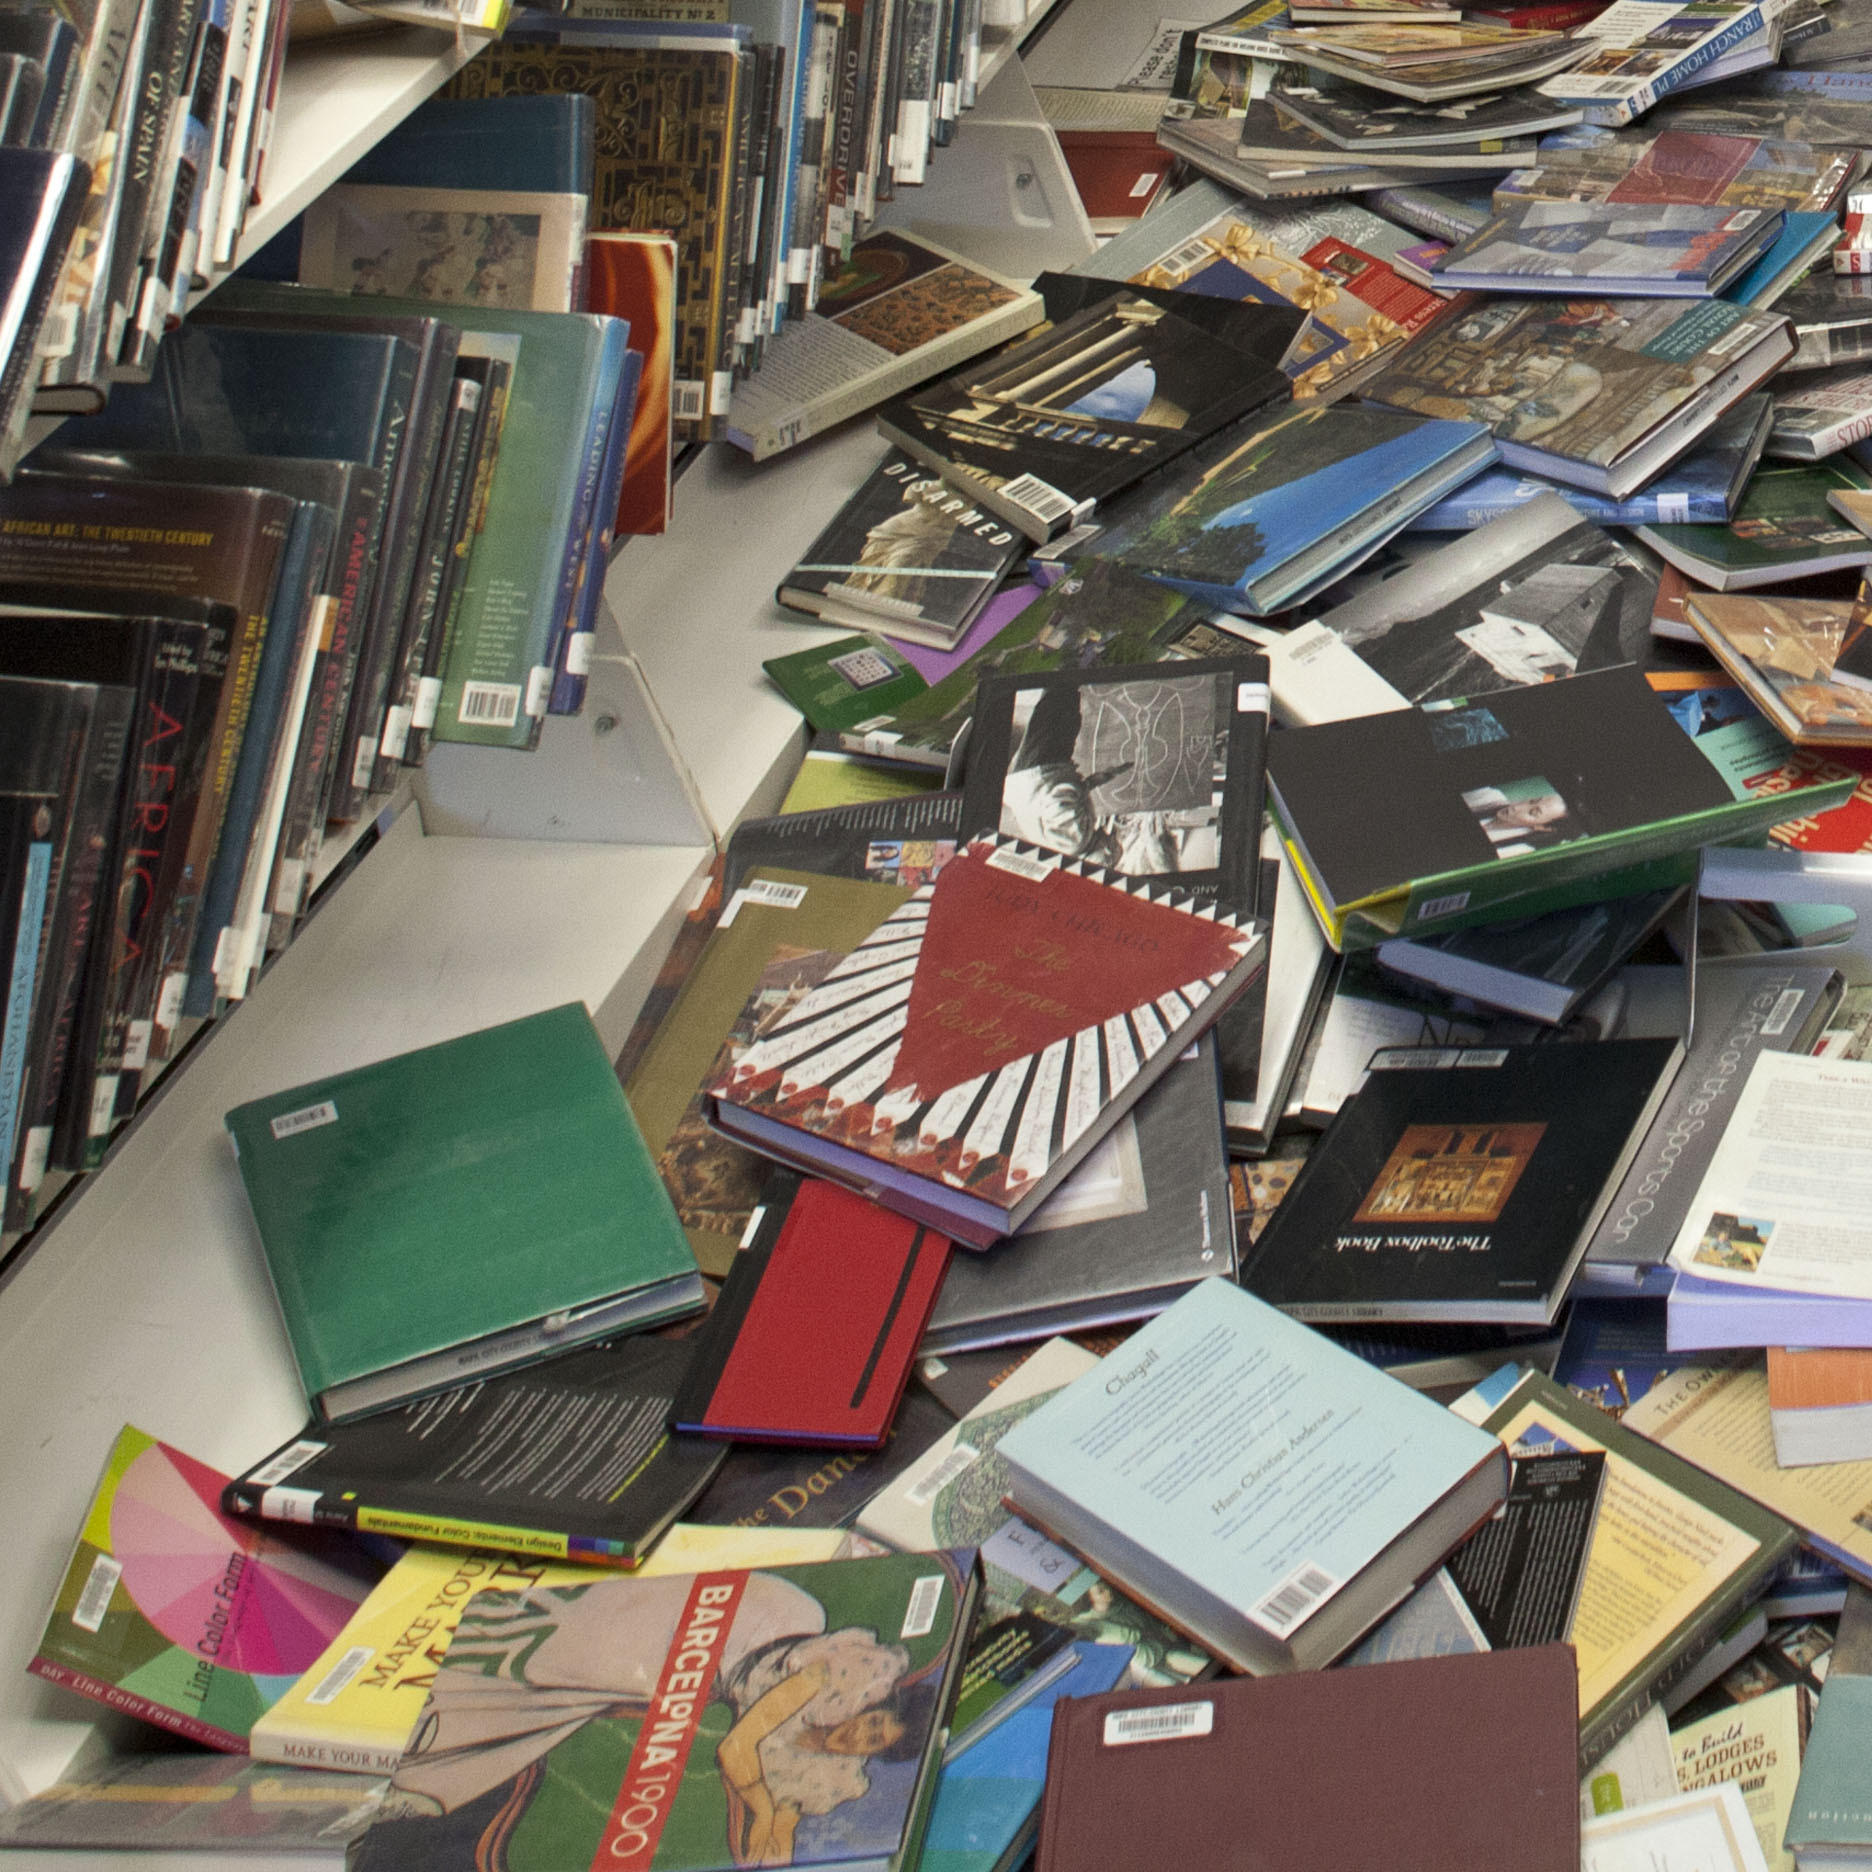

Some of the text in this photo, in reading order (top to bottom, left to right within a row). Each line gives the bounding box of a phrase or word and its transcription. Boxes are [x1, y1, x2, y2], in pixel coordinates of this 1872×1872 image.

[241, 6, 258, 52] ART
[1668, 12, 1759, 85] RANCH HOME
[133, 71, 164, 183] OF SPAIN
[831, 50, 860, 206] OVERDRIVE
[881, 455, 1017, 553] DISARMED
[108, 699, 184, 983] AFRICA
[1012, 940, 1068, 971] The
[941, 963, 1074, 1020] Dinner
[922, 998, 1019, 1052] Party
[1632, 1106, 1706, 1200] Sports
[1334, 1234, 1491, 1252] The Toolbox Book
[1606, 1189, 1657, 1249] Car
[1101, 1346, 1163, 1401] Chagall
[1209, 1402, 1337, 1515] Hans Christian Andersen
[441, 1526, 471, 1539] Color
[524, 1534, 562, 1551] Design
[184, 1549, 252, 1704] Line Color Form
[360, 1608, 441, 1698] MAKE
[39, 1663, 183, 1729] DAY Line Color Form
[638, 1586, 734, 1771] BARCELONA
[282, 1742, 328, 1762] MAKE
[329, 1748, 373, 1767] YOUR
[1681, 1721, 1744, 1762] to Build
[608, 1770, 670, 1853] 1900
